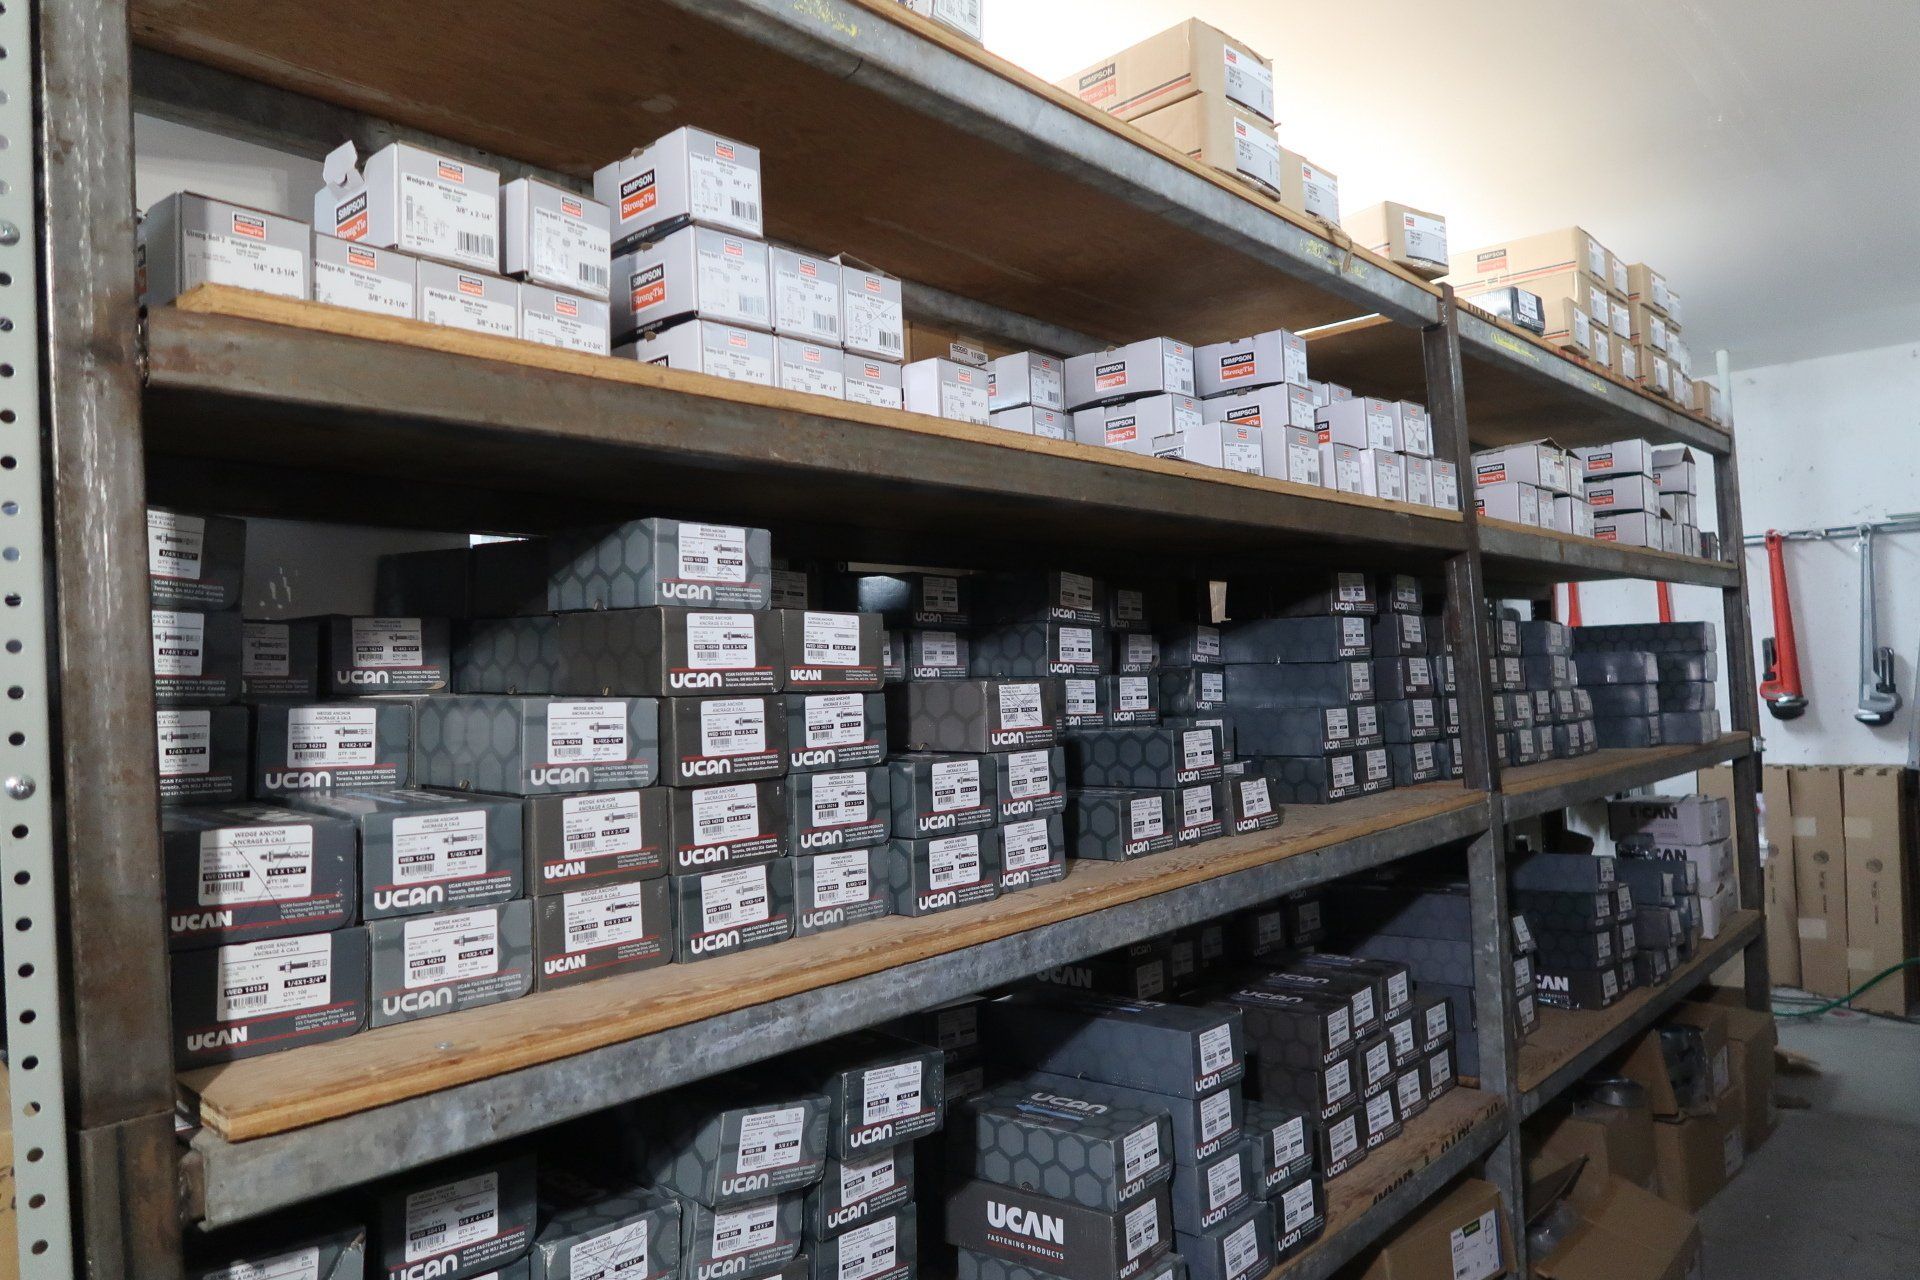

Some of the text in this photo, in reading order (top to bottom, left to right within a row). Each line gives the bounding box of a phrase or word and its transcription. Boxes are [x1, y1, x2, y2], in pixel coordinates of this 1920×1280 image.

[1080, 67, 1113, 87] SIMPSON
[622, 172, 653, 196] SIMPSON
[336, 195, 367, 220] SIMPSON
[622, 191, 655, 214] Strong-Tie
[1478, 250, 1505, 260] SIMPSON
[632, 266, 662, 287] SIMPSON
[632, 284, 664, 303] Strong-Tie
[1222, 353, 1253, 365] SIMPSON
[1097, 363, 1124, 374] SIMPSON
[1228, 407, 1258, 418] SIMPSON
[1106, 418, 1134, 429] SIMPSON
[1587, 453, 1612, 462] SIMPSON
[1477, 464, 1503, 473] SIMPSON
[1589, 490, 1613, 498] SIMPSON
[662, 583, 712, 601] UCAN
[1052, 608, 1077, 620] UCAN
[1334, 602, 1355, 612] UCAN
[915, 612, 942, 624] UCAN
[336, 670, 389, 684] UCAN
[791, 669, 822, 685] UCAN
[914, 666, 940, 678] UCAN
[1049, 662, 1075, 674] UCAN
[670, 673, 722, 689] UCAN
[1113, 710, 1136, 722] UCAN
[991, 731, 1025, 746] UCAN
[790, 748, 836, 767] UCAN
[531, 766, 590, 786] UCAN
[681, 757, 732, 778] UCAN
[1177, 770, 1201, 783] UCAN
[265, 771, 331, 790] UCAN
[1002, 799, 1033, 816] UCAN
[919, 813, 956, 831] UCAN
[1236, 817, 1260, 832] UCAN
[233, 837, 263, 846] ANCRAGE
[800, 829, 843, 849] UCAN
[1178, 827, 1201, 842] UCAN
[679, 844, 729, 867] UCAN
[1125, 839, 1150, 856] UCAN
[543, 860, 587, 879] UCAN
[999, 871, 1030, 888] UCAN
[373, 885, 444, 910] UCAN
[918, 889, 957, 911] UCAN
[172, 910, 233, 932] UCAN
[802, 907, 844, 928] UCAN
[277, 940, 299, 948] ANCHOR
[691, 929, 741, 955] UCAN
[543, 953, 587, 975] UCAN
[226, 984, 267, 997] WED 14134
[286, 975, 325, 988] 1/4X1-3/4"
[382, 987, 453, 1017] UCAN
[1240, 990, 1304, 1004] UCAN
[1384, 1008, 1400, 1022] UCAN
[186, 1025, 249, 1051] UCAN
[1424, 1038, 1440, 1052] UCAN
[1324, 1049, 1341, 1064] UCAN
[1195, 1073, 1221, 1092] UCAN
[1365, 1081, 1382, 1097] UCAN
[1031, 1092, 1108, 1115] UCAN
[1322, 1102, 1341, 1119] UCAN
[850, 1123, 894, 1148] UCAN
[1197, 1140, 1221, 1160] UCAN
[1265, 1164, 1291, 1187] UCAN
[1327, 1158, 1348, 1178] UCAN
[721, 1173, 769, 1196] UCAN
[1118, 1178, 1146, 1202] UCAN
[827, 1202, 868, 1229] UCAN
[987, 1200, 1064, 1245] UCAN
[1202, 1206, 1228, 1228] UCAN
[987, 1233, 1064, 1261] FASTENING PRODUCTS
[1277, 1228, 1302, 1252] UCAN
[698, 1256, 746, 1280] UCAN
[1120, 1258, 1140, 1280] UCAN
